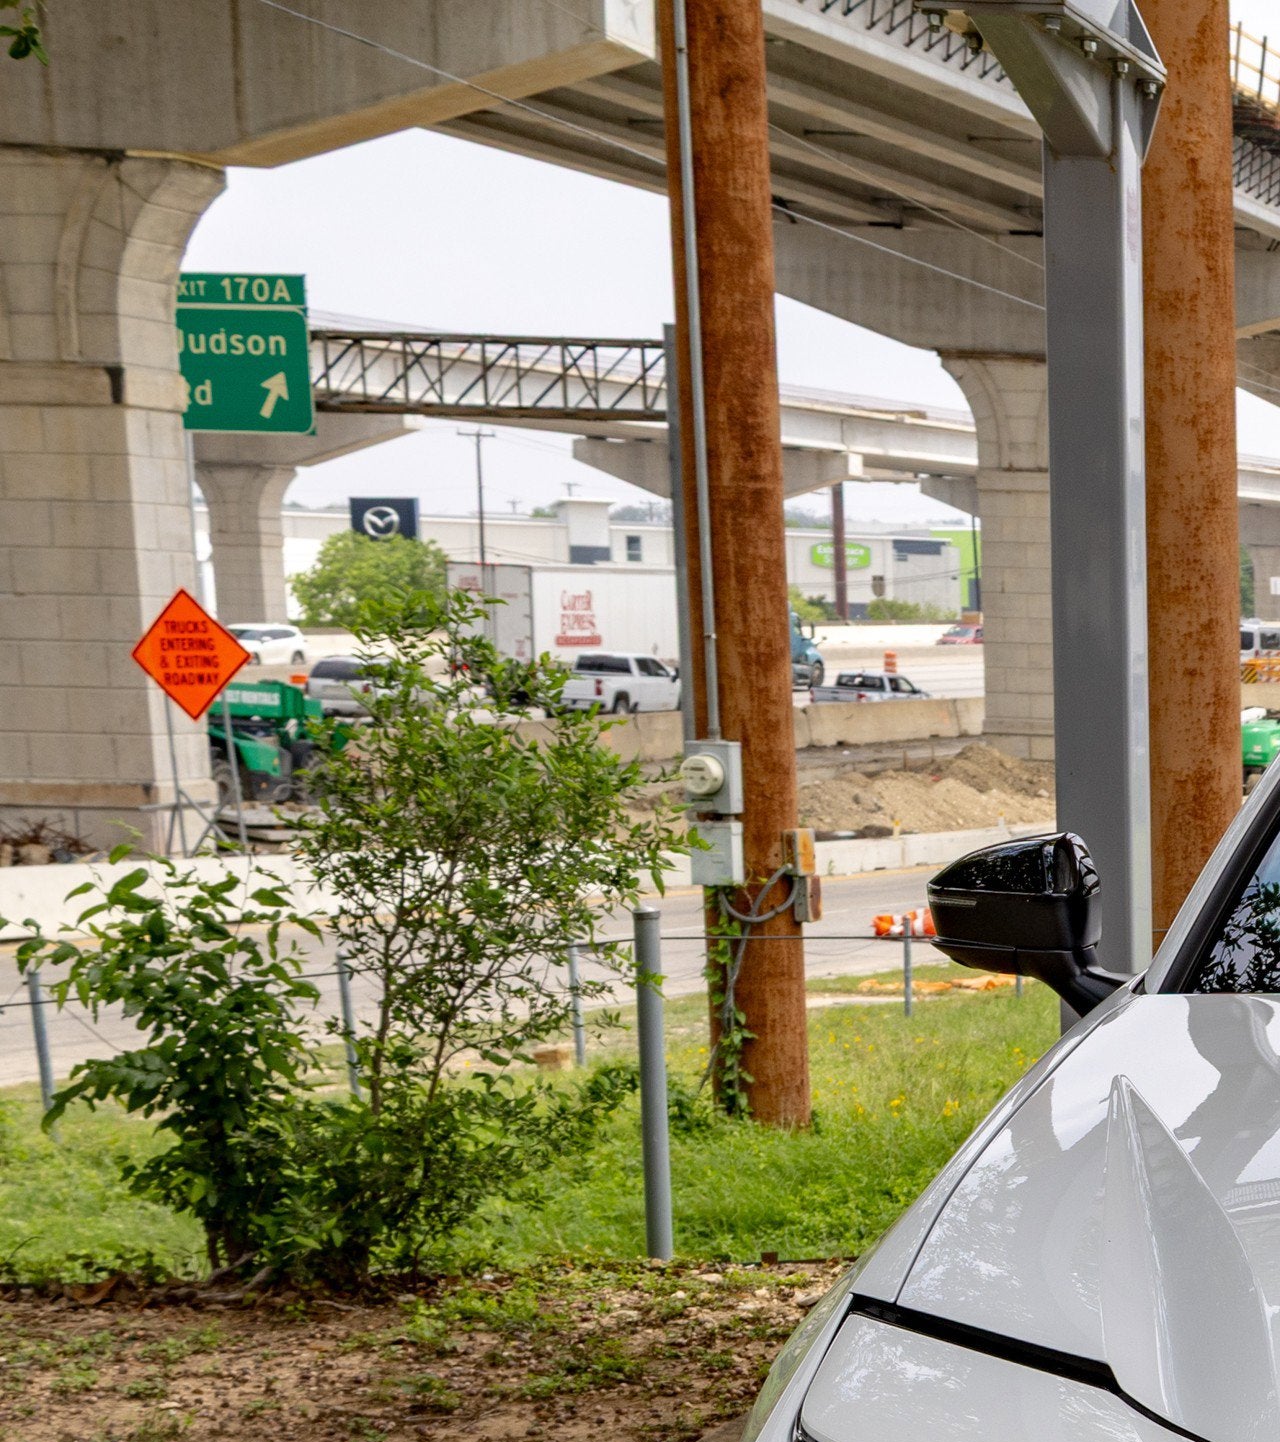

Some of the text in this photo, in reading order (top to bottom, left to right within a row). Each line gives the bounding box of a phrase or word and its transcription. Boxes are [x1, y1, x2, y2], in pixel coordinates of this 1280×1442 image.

[177, 278, 291, 302] XIT 170A
[164, 620, 208, 634] TRUCKS
[160, 638, 215, 651] ENTERING
[160, 655, 220, 669] & EXITING
[164, 673, 220, 686] ROADWAY
